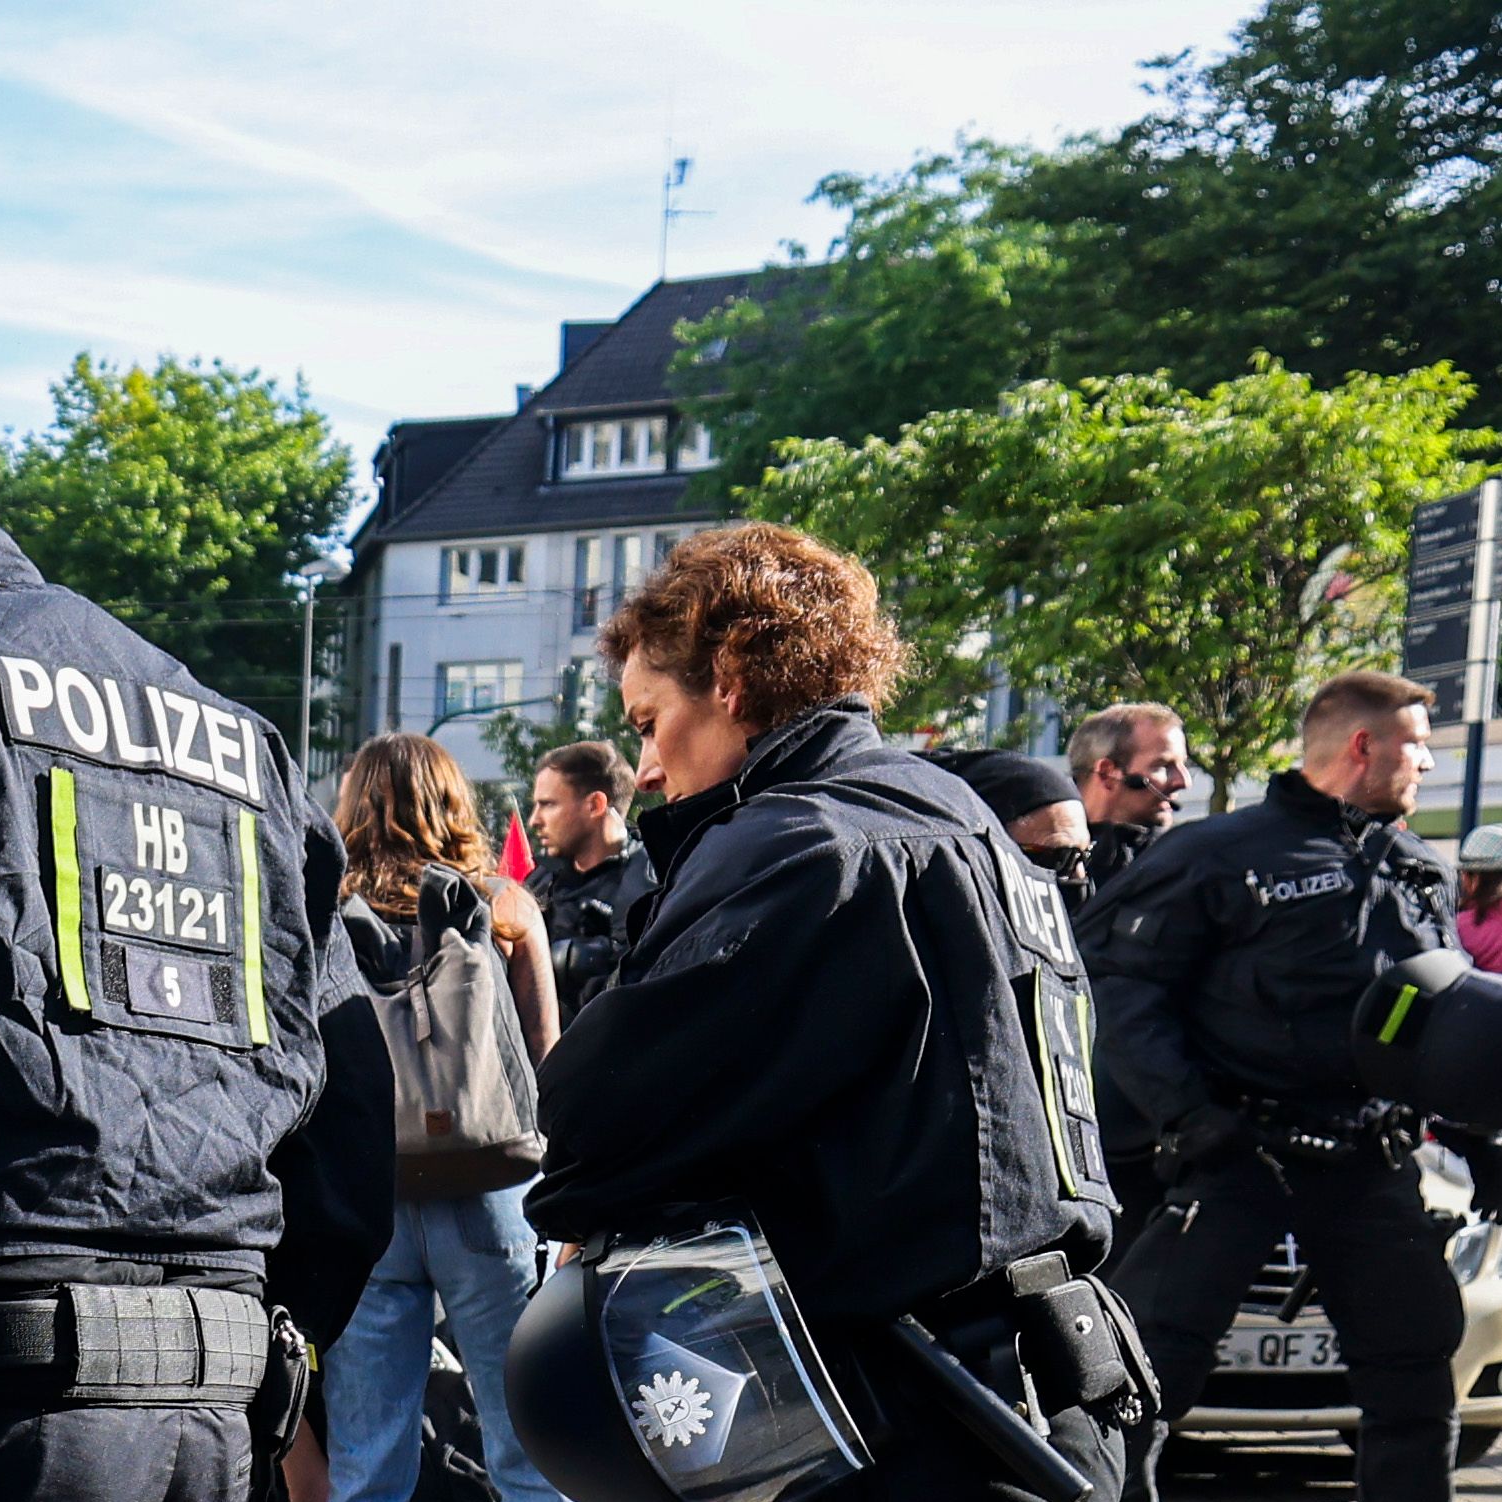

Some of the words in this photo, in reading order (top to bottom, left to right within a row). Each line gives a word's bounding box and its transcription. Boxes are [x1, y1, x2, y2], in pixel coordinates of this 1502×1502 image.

[0, 655, 262, 801] POLIZEI
[133, 802, 188, 875] HB
[104, 873, 227, 944] 23121
[162, 966, 181, 1007] 5
[1259, 1334, 1304, 1366] QF
